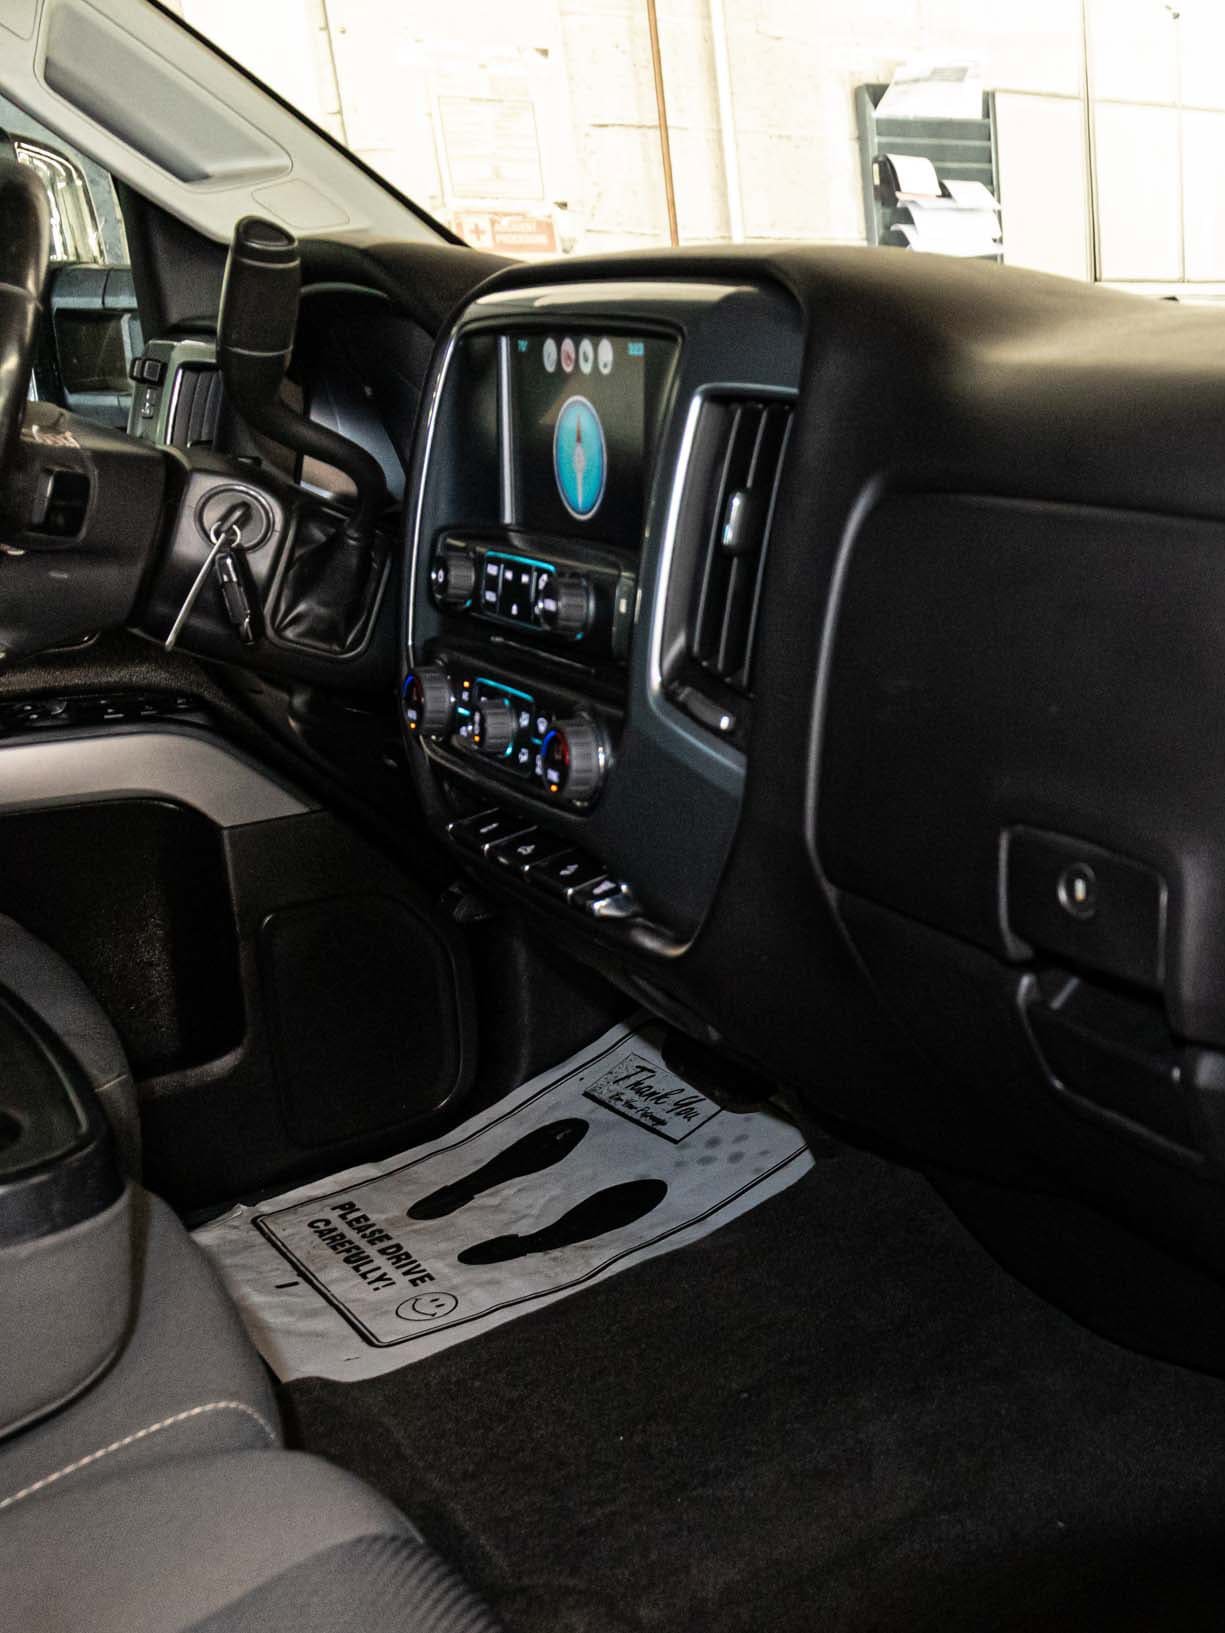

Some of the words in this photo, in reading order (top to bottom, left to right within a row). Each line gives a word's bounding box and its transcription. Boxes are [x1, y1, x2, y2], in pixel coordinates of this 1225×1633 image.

[613, 1065, 685, 1105] Thank
[666, 1095, 706, 1121] You
[307, 1218, 396, 1291] CAREFULLY!
[331, 1201, 393, 1246] PLEASE
[378, 1243, 436, 1287] DRIVE
